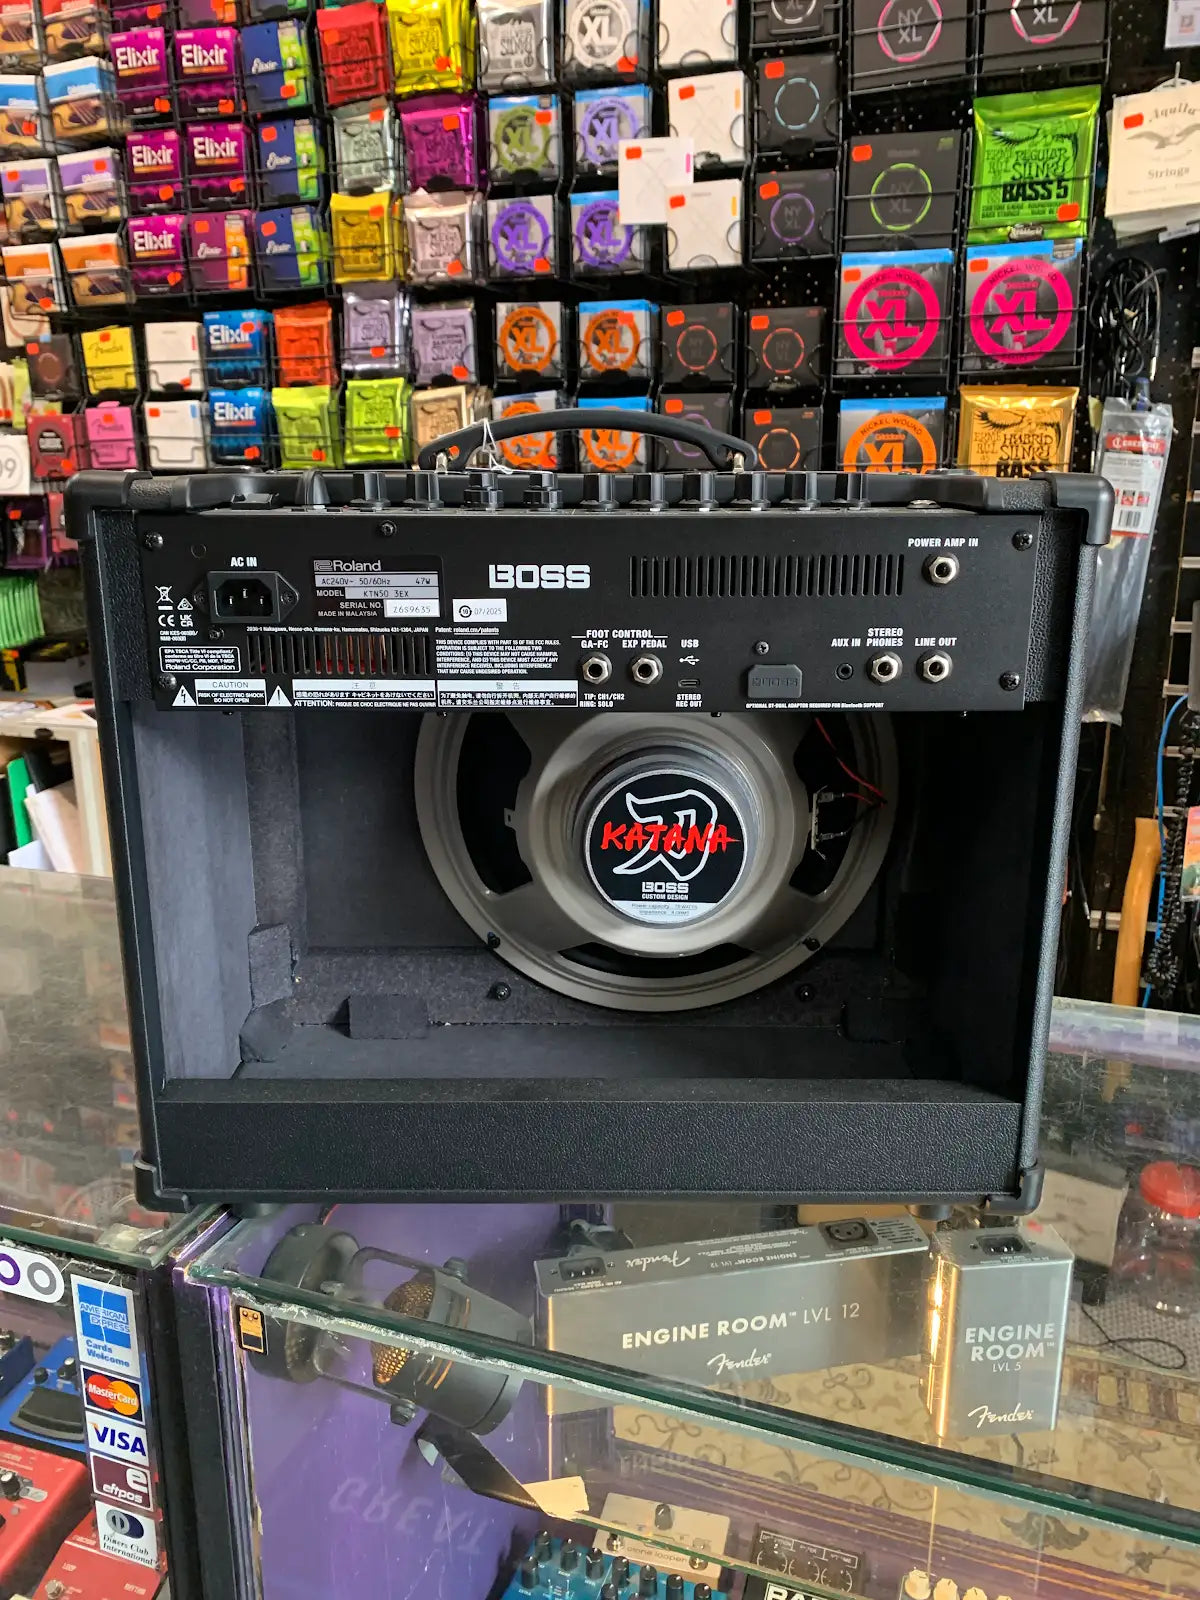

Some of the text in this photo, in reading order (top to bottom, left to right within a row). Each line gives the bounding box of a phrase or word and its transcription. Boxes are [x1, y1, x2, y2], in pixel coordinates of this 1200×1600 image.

[897, 7, 923, 27] NY
[1032, 7, 1059, 25] XL
[582, 15, 619, 46] XL
[897, 27, 923, 44] XL
[116, 46, 160, 70] Elixir
[181, 44, 228, 68] Elixir
[193, 137, 238, 159] Elixir
[504, 128, 540, 153] XL
[131, 145, 174, 168] Elixir
[1001, 177, 1069, 203] BASS 5
[133, 230, 176, 253] Elixir
[504, 223, 539, 251] XL
[586, 220, 622, 247] XL
[862, 299, 920, 339] XL
[990, 291, 1051, 334] XL
[508, 327, 544, 355] XL
[595, 327, 630, 353] XL
[213, 401, 257, 421] Elixir
[860, 417, 923, 436] NICKEL WOUND
[596, 429, 630, 451] XL
[1002, 432, 1054, 446] HYBRID
[863, 442, 918, 474] XL
[999, 444, 1051, 461] SLINKY
[996, 461, 1053, 478] BASS
[908, 538, 979, 547] POWER AMP IN
[230, 557, 258, 567] AC IN
[333, 560, 381, 571] Roland
[488, 564, 591, 589] BOSS
[474, 607, 502, 615] 07/2025
[586, 630, 653, 638] FOOT CONTROL
[831, 638, 861, 647] AUX IN
[866, 638, 904, 647] PHONES
[867, 628, 904, 637] STEREO
[914, 637, 957, 646] LINE OUT
[581, 639, 699, 648] GA-FC EXP PEDAL USB
[212, 681, 249, 689] CAUTION
[601, 821, 742, 854] KATANA
[641, 881, 689, 893] BOSS
[626, 1250, 691, 1272] Fender
[80, 1302, 127, 1323] AMERICAN
[90, 1315, 131, 1333] EXPRESS
[622, 1322, 709, 1350] ENGINE
[803, 1307, 832, 1325] LVL
[841, 1303, 860, 1319] 12
[965, 1323, 1055, 1343] ENGINE
[86, 1339, 113, 1354] Cards
[86, 1349, 130, 1368] Welcome
[992, 1361, 1022, 1372] LVL 5
[88, 1383, 138, 1405] MasterCard
[93, 1424, 147, 1456] VISA
[103, 1483, 143, 1504] eftpos
[103, 1534, 128, 1549] Diners
[130, 1543, 149, 1556] Club
[103, 1543, 153, 1566] International
